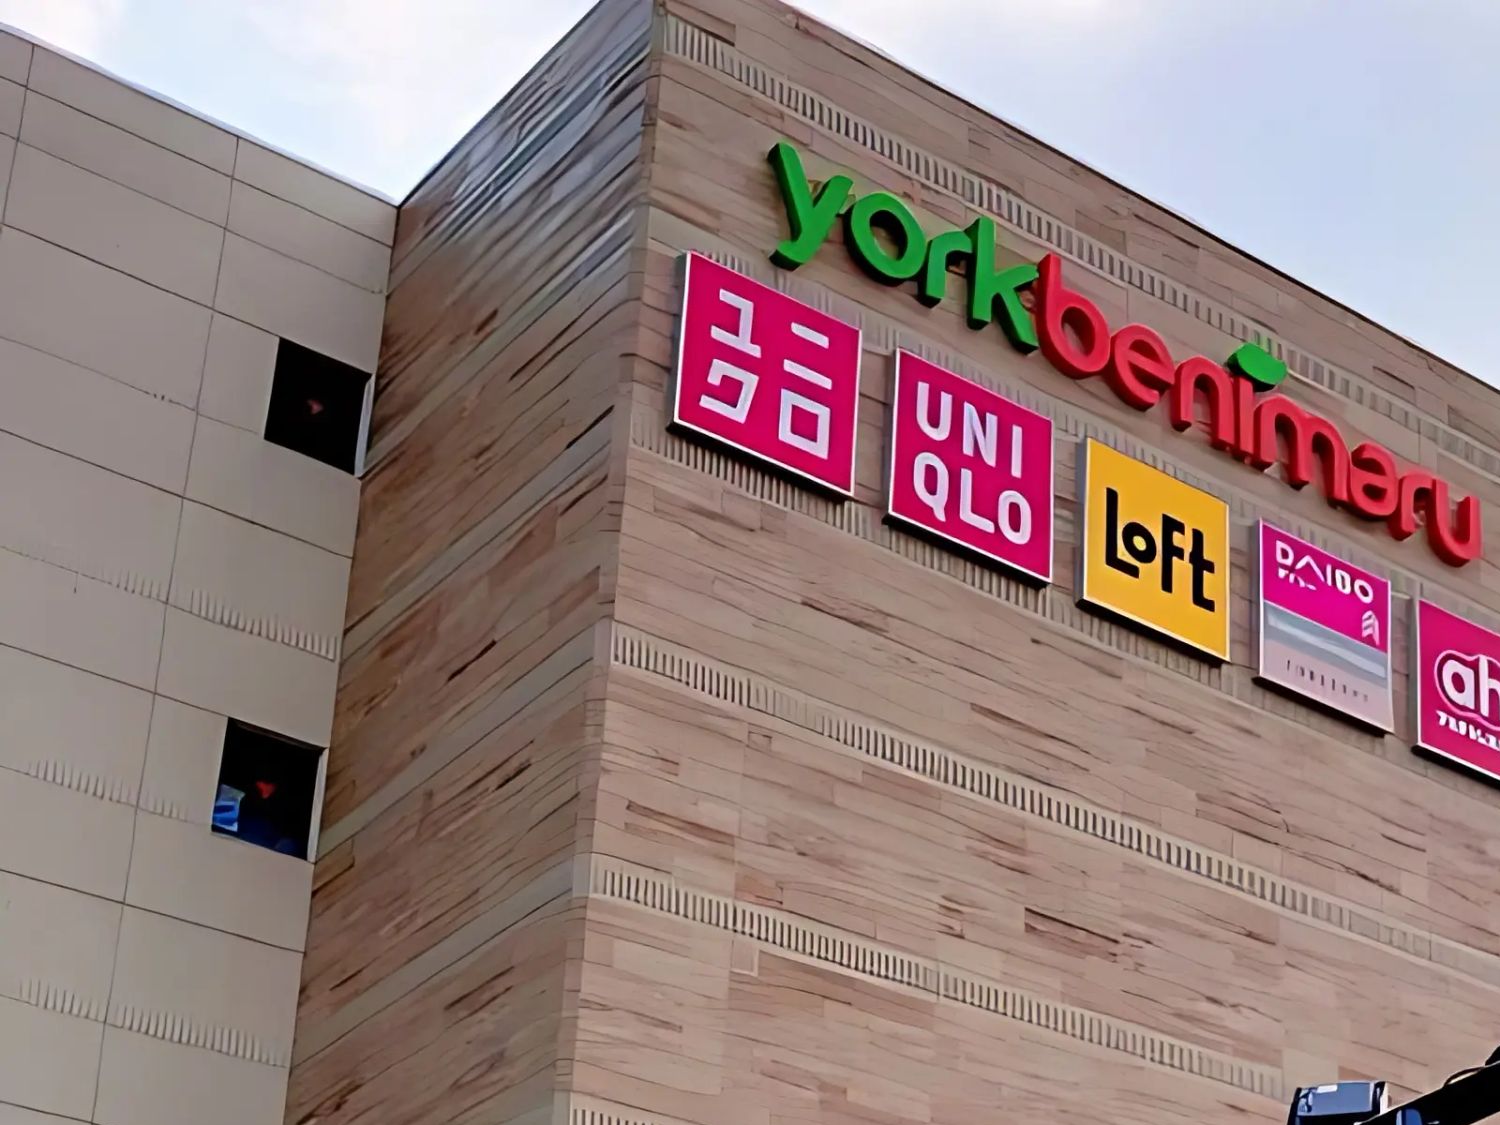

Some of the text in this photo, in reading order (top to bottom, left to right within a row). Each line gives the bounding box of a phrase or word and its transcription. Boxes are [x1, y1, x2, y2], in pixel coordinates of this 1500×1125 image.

[767, 141, 1482, 567] yorkbenimaru
[916, 381, 1023, 478] UNI
[913, 451, 1032, 545] QLO
